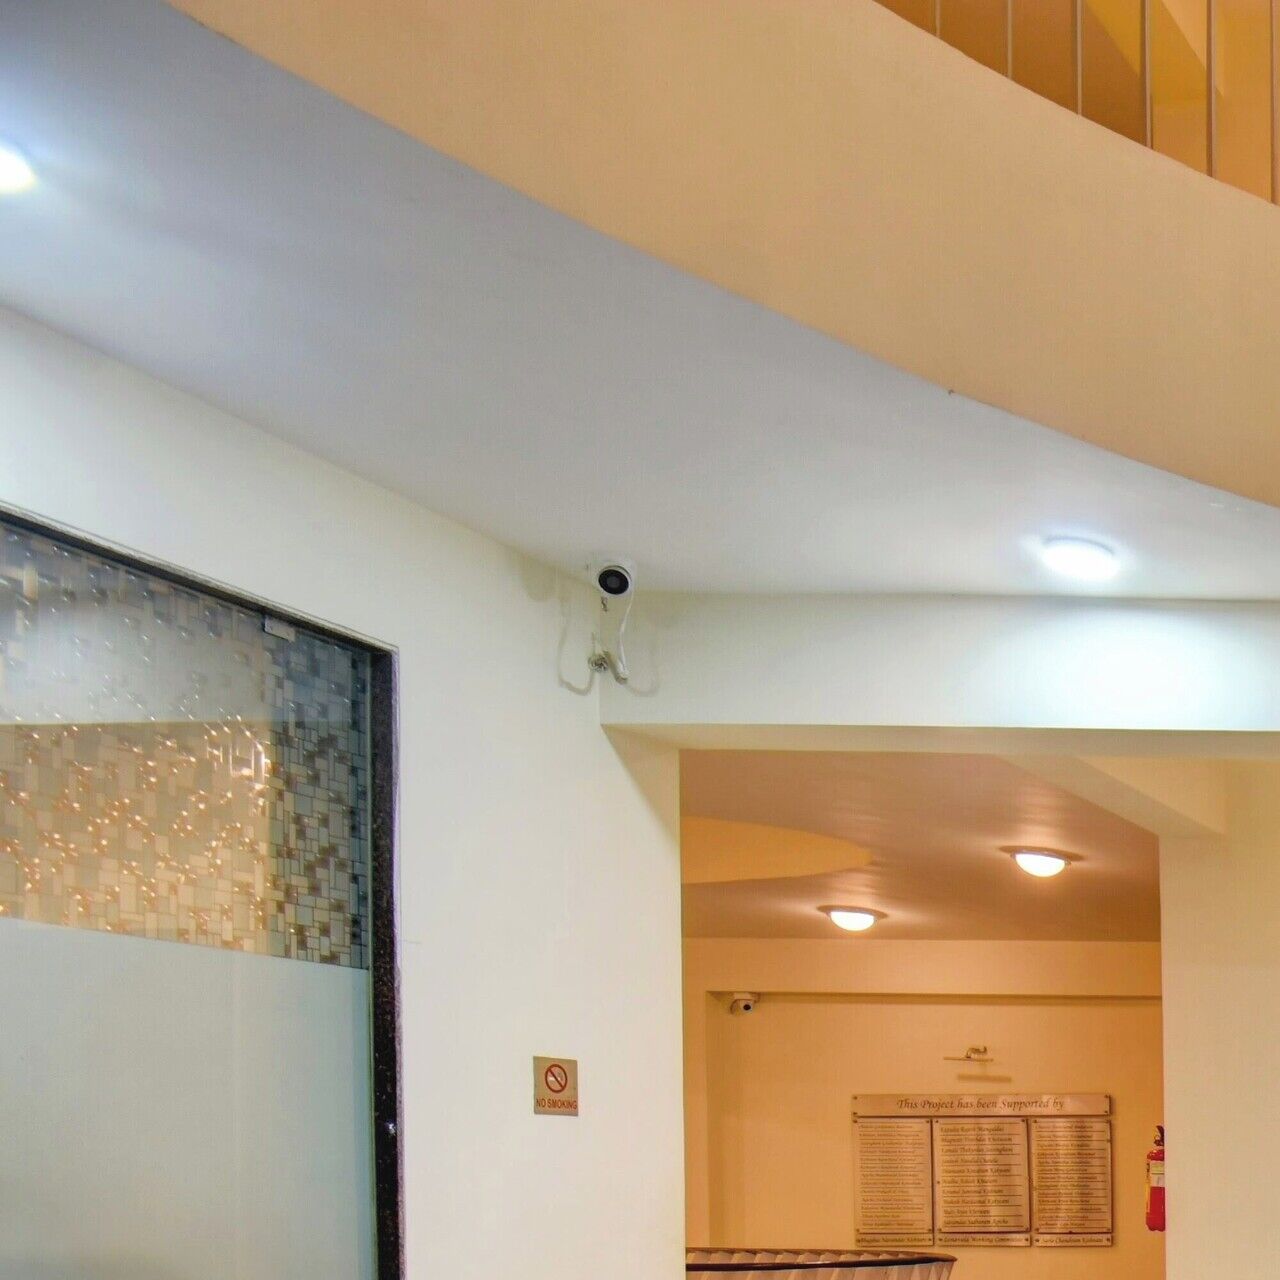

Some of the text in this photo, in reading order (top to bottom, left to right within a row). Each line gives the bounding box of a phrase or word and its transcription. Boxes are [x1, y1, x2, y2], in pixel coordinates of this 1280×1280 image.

[536, 1098, 578, 1110] NO SMOKING
[896, 1098, 1064, 1112] This Project has been Supported by
